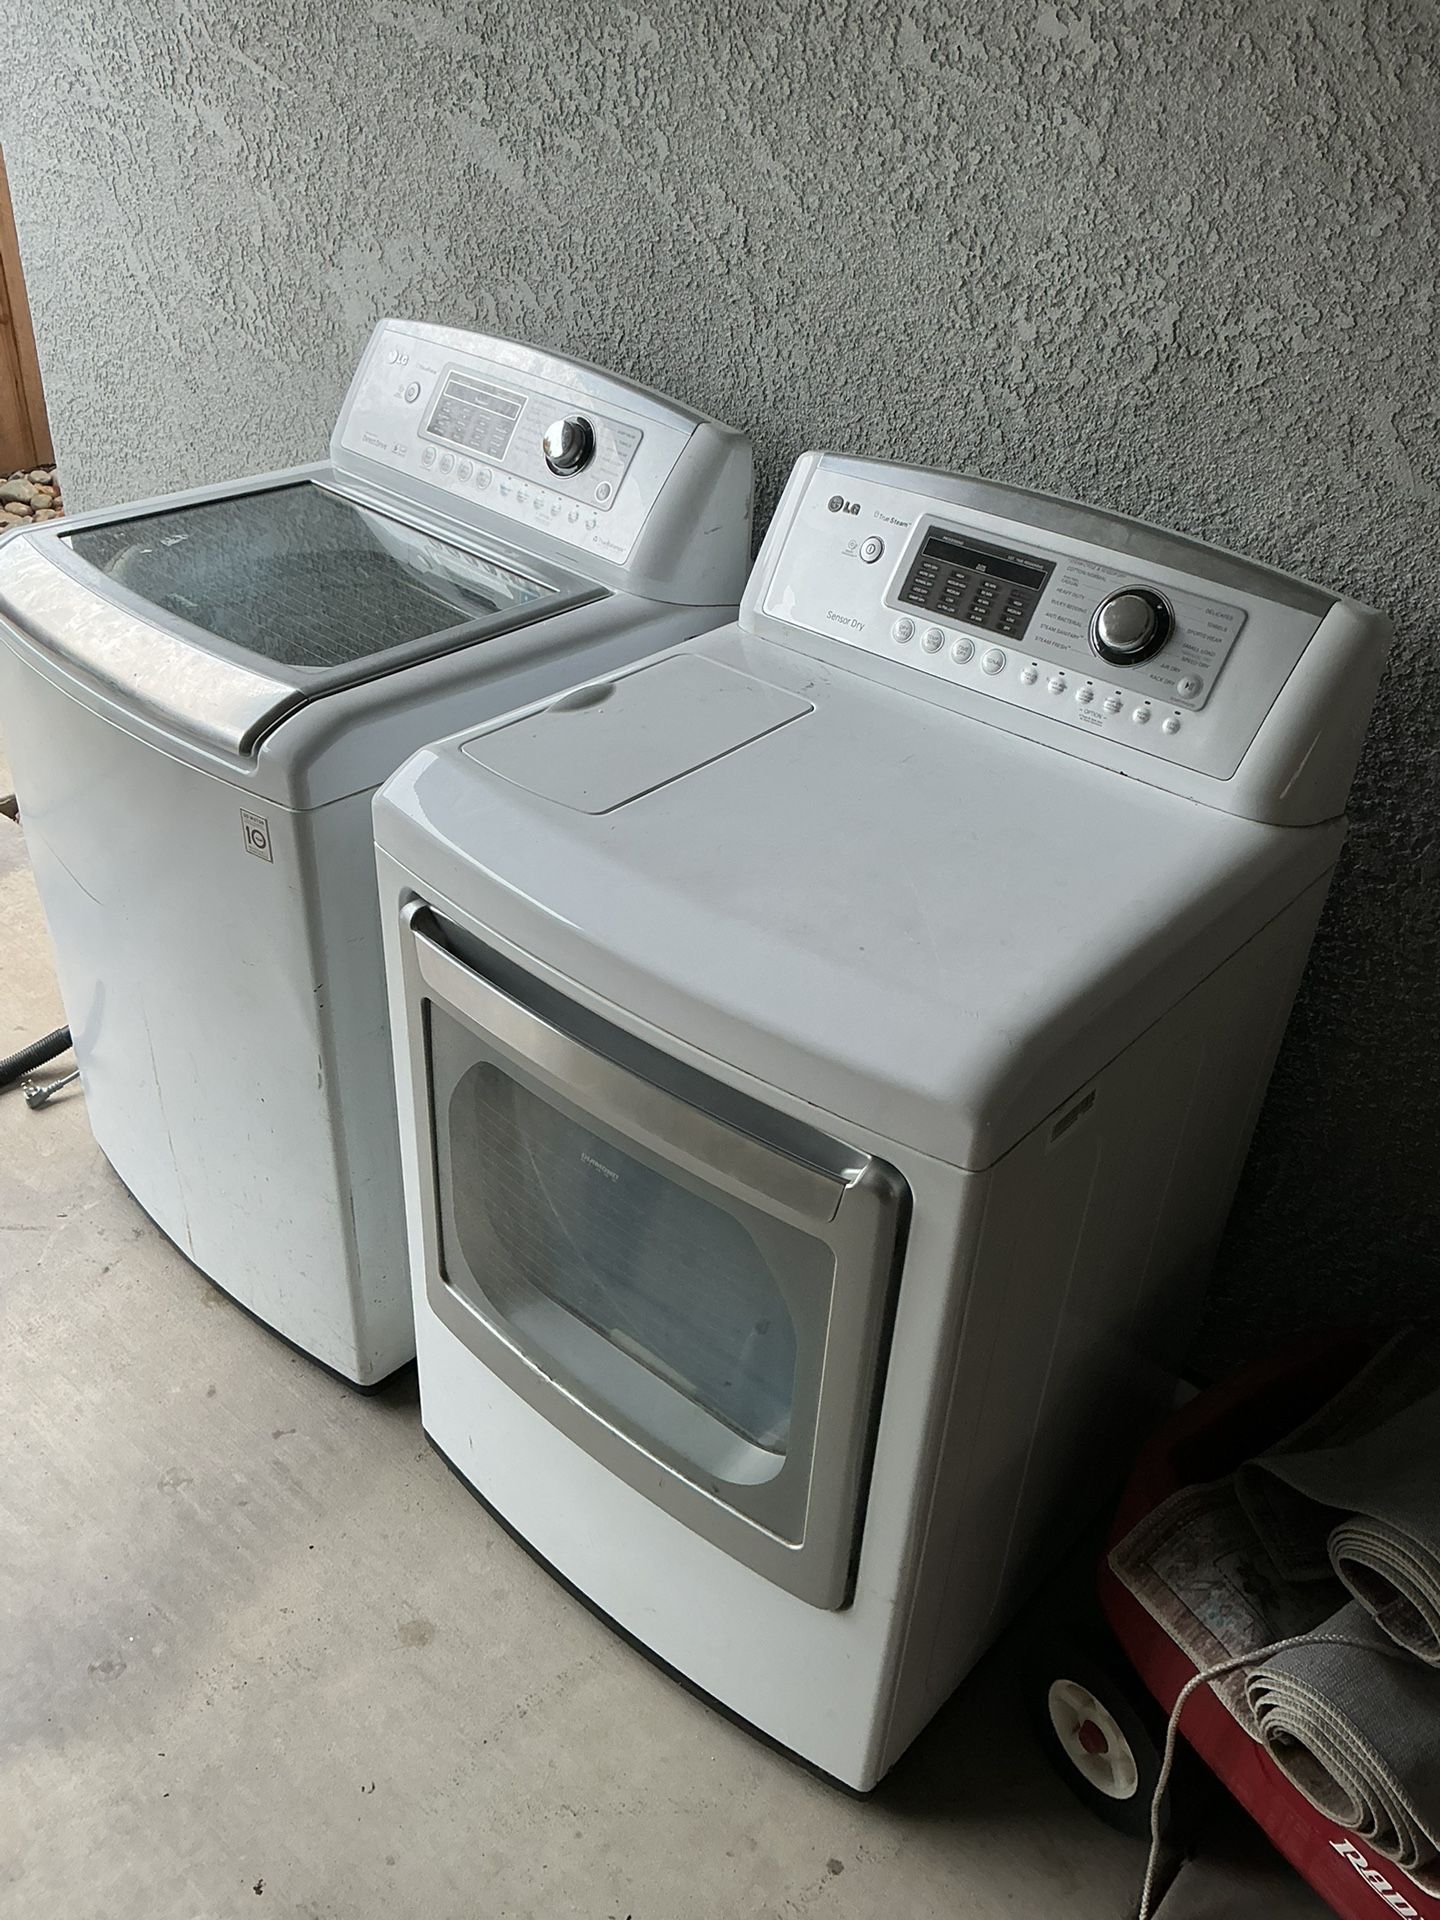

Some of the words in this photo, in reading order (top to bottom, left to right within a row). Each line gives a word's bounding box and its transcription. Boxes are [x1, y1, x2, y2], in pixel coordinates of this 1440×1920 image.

[826, 610, 851, 625] Sensor
[850, 618, 865, 632] Dry
[1329, 1838, 1425, 1920] RAD
